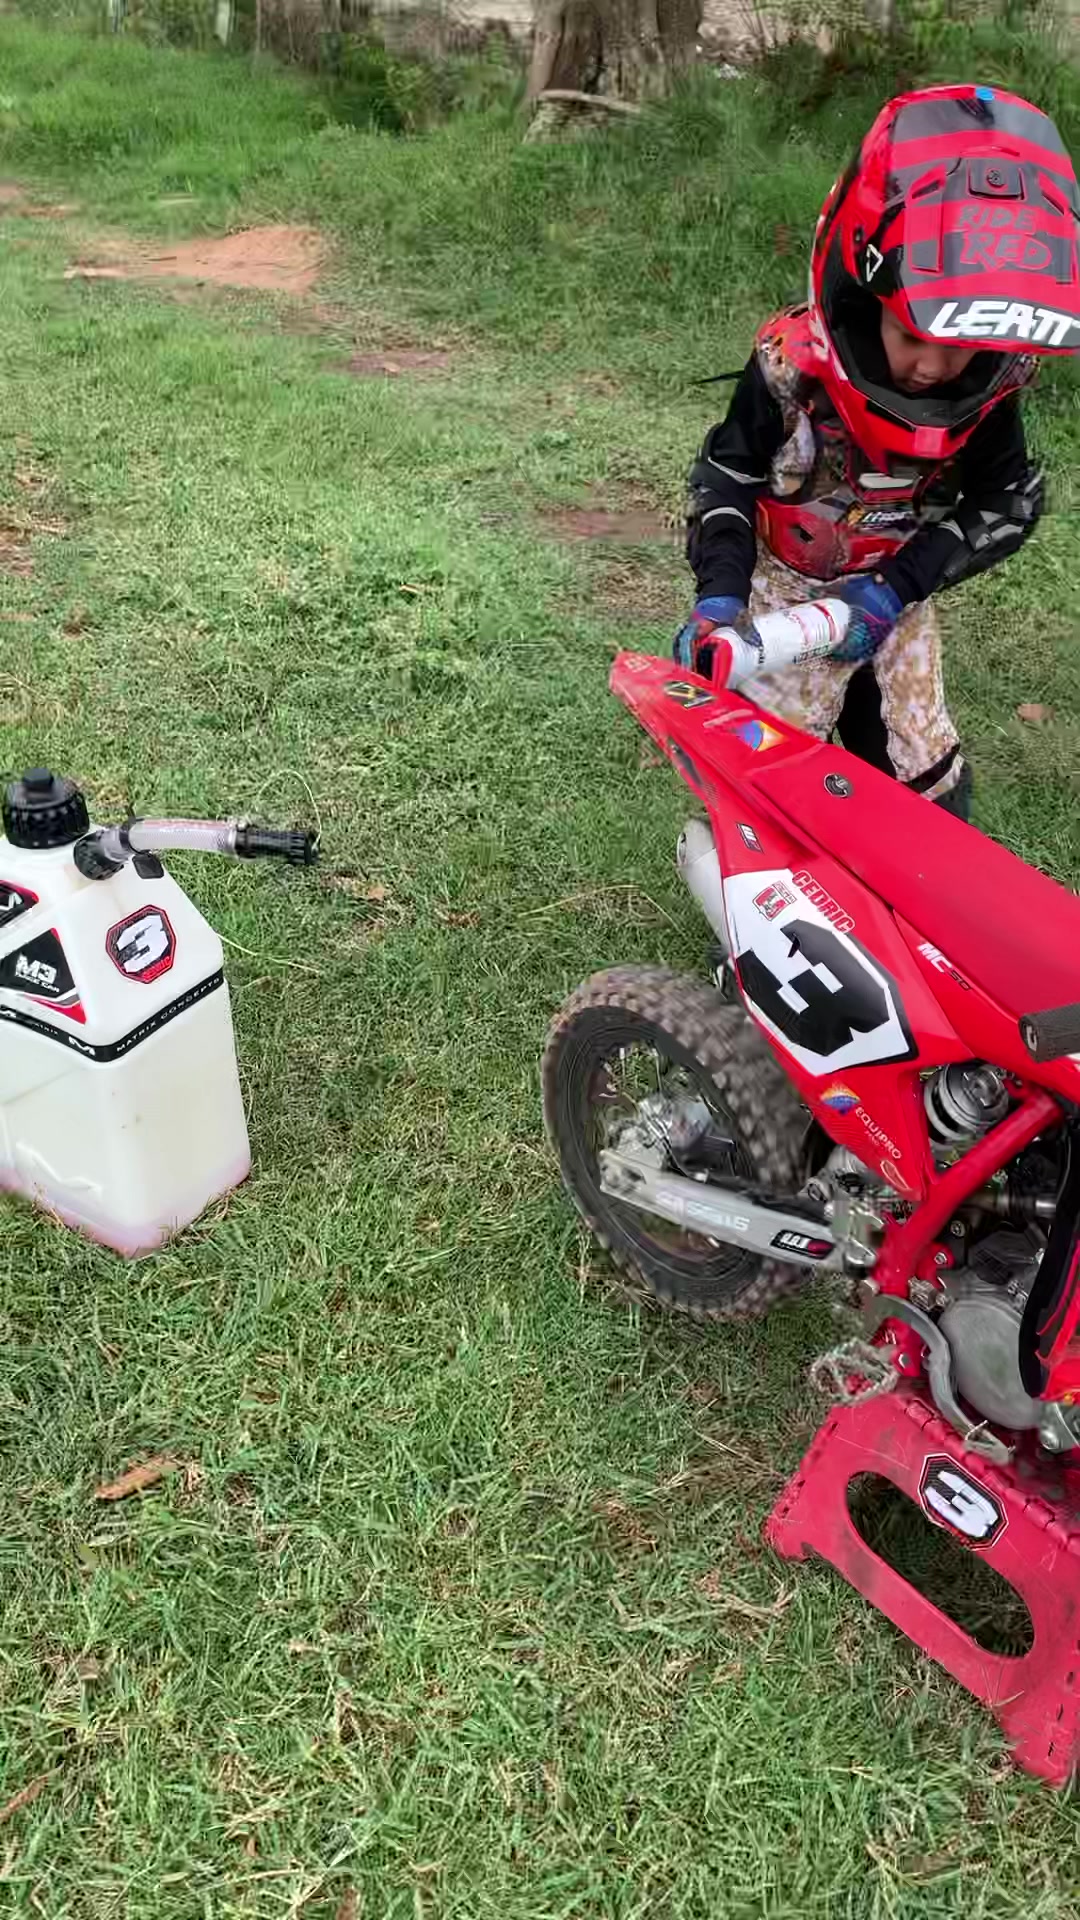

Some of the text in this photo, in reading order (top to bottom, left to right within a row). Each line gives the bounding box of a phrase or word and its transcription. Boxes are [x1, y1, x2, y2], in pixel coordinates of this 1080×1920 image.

[960, 204, 1035, 230] RIDE
[961, 231, 1052, 269] RED
[928, 300, 1077, 346] LEATT
[791, 869, 855, 933] CEDRIC
[15, 953, 57, 984] M3
[116, 914, 170, 974] 3
[917, 942, 952, 973] MC
[735, 918, 892, 1056] 3
[116, 977, 220, 1052] MATRIX CONCEPTS
[855, 1106, 902, 1159] EQUIPRO
[925, 1470, 1000, 1538] 3
